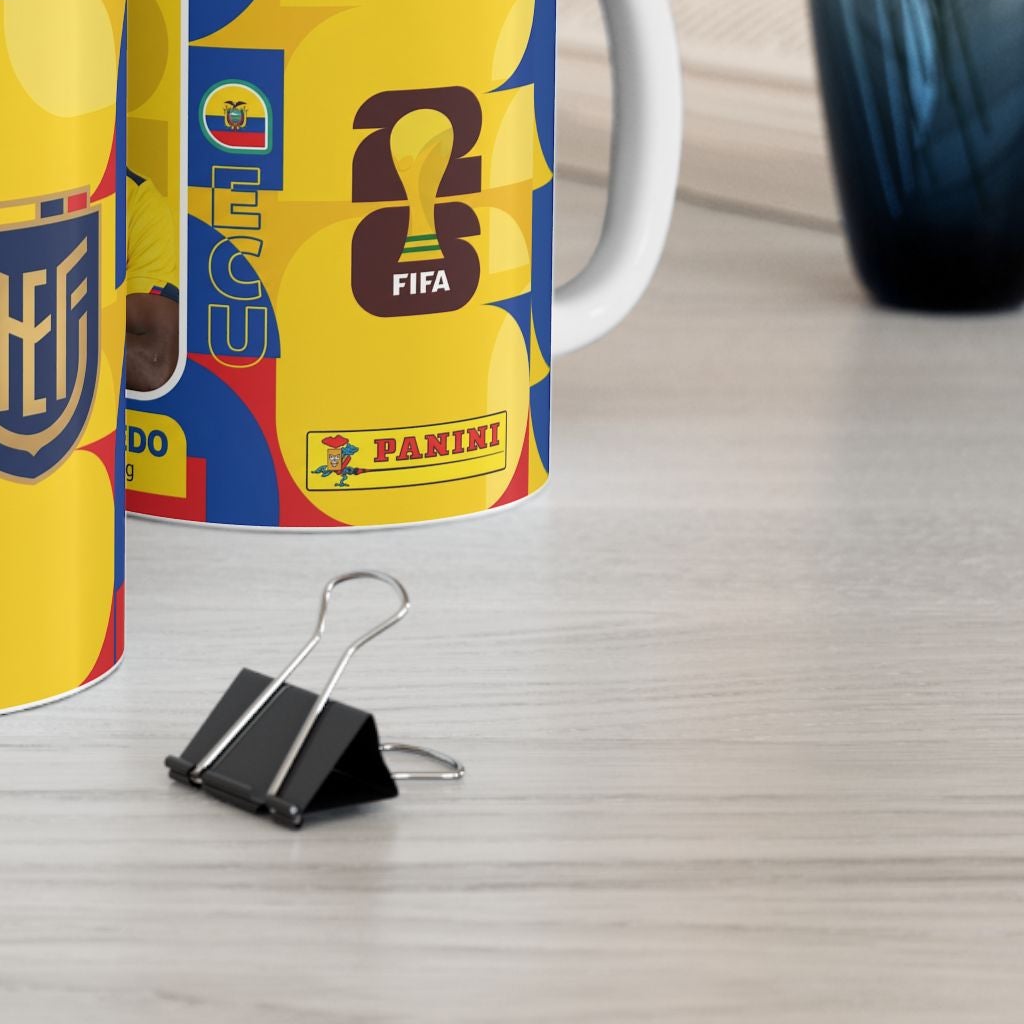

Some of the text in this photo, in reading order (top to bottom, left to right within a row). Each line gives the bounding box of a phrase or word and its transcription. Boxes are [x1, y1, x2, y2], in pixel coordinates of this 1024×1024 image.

[208, 165, 268, 369] ECU
[392, 269, 451, 296] FIFA
[125, 425, 169, 458] DO
[373, 422, 501, 463] PANINI
